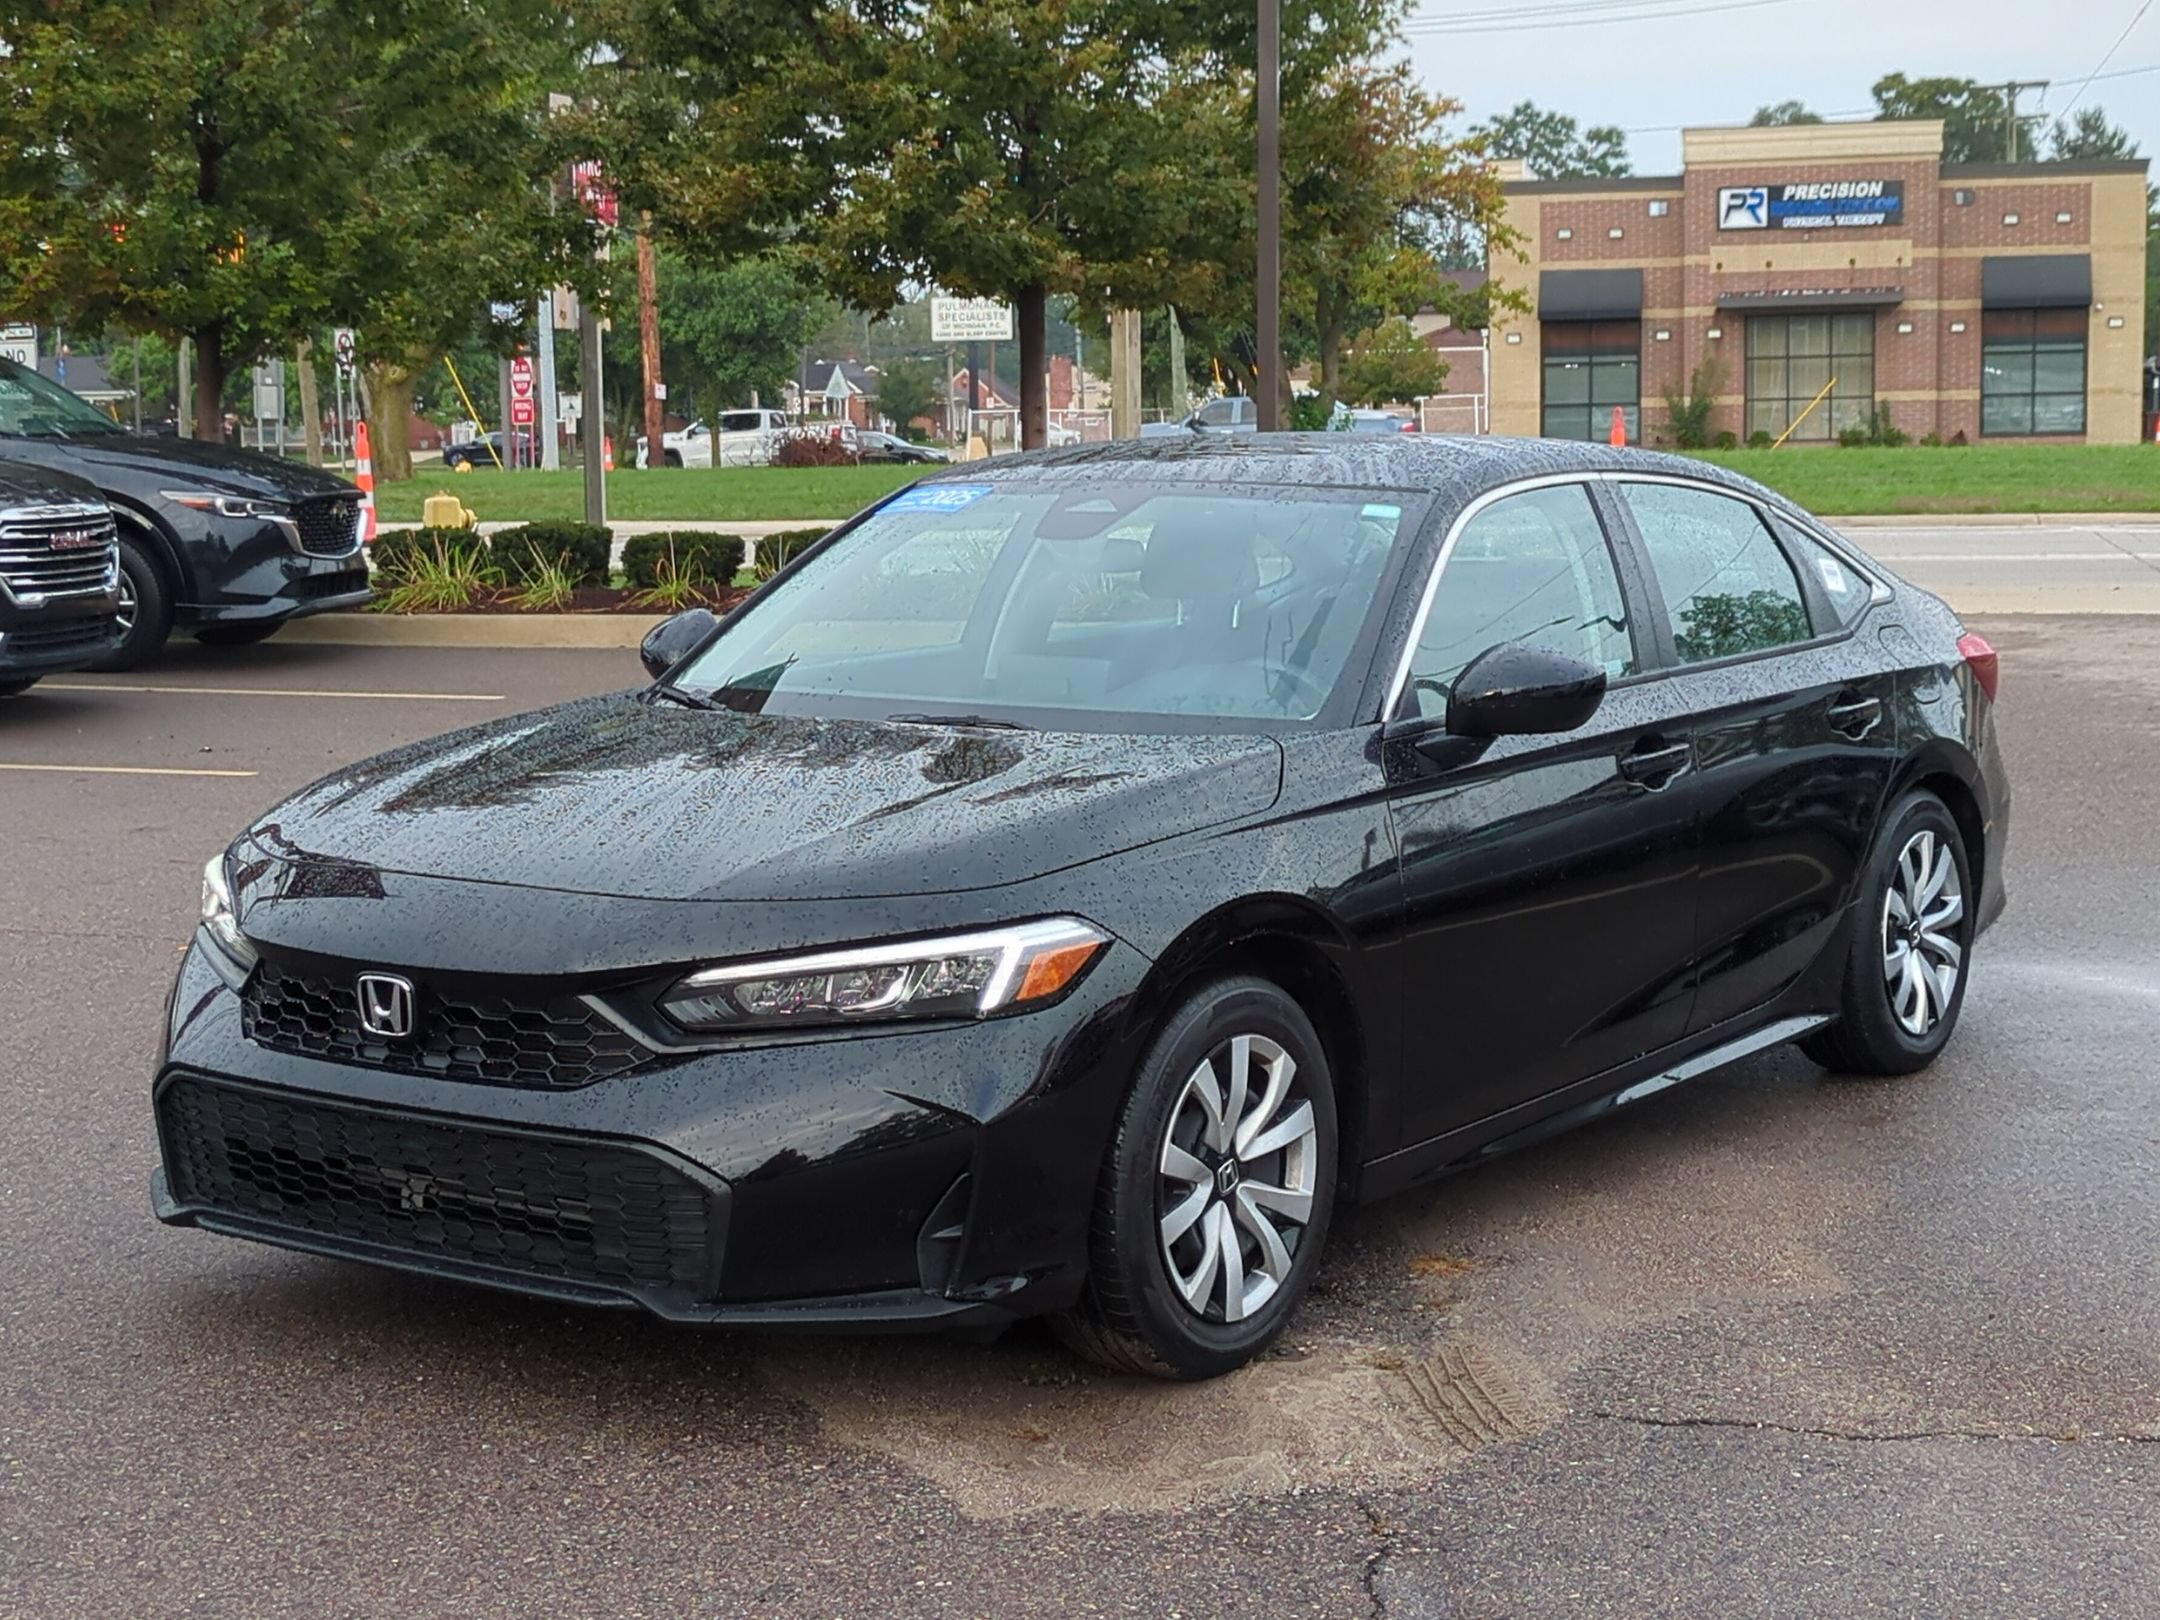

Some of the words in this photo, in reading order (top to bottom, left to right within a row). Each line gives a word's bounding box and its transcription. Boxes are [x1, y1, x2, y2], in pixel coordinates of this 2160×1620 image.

[1782, 181, 1884, 201] PRECISION
[938, 301, 1004, 311] PULMONAR
[938, 311, 1006, 322] SPECIALISTS
